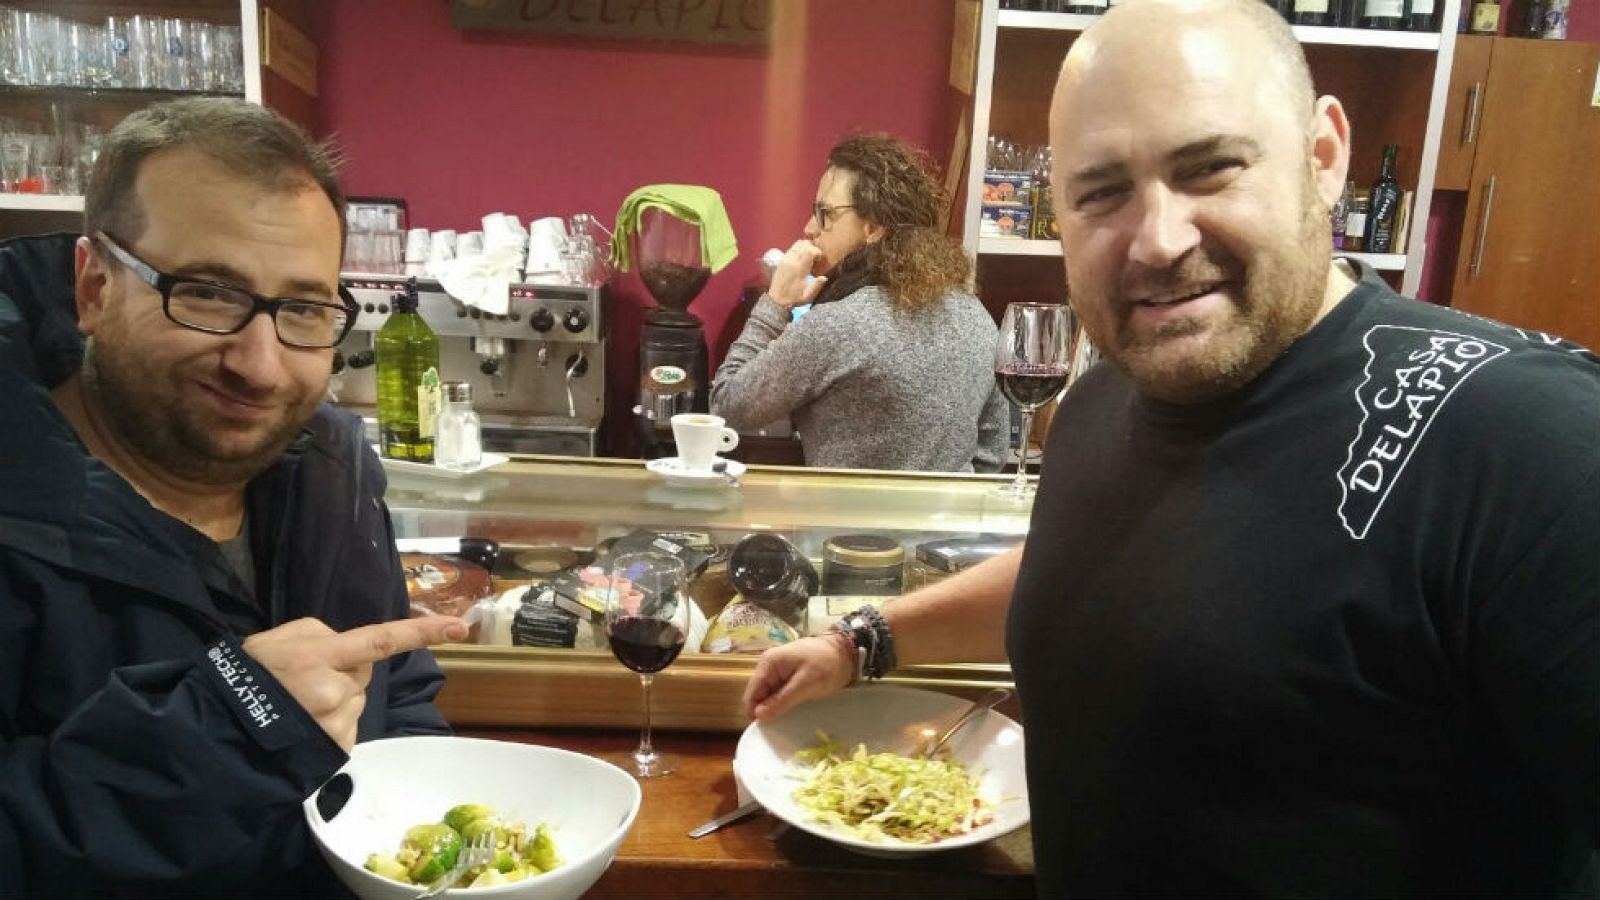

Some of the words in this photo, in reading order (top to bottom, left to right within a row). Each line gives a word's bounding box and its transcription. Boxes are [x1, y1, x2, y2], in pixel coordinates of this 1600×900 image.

[1374, 335, 1463, 410] CASA
[1350, 340, 1488, 493] DELAPIO
[233, 685, 272, 728] HELLY
